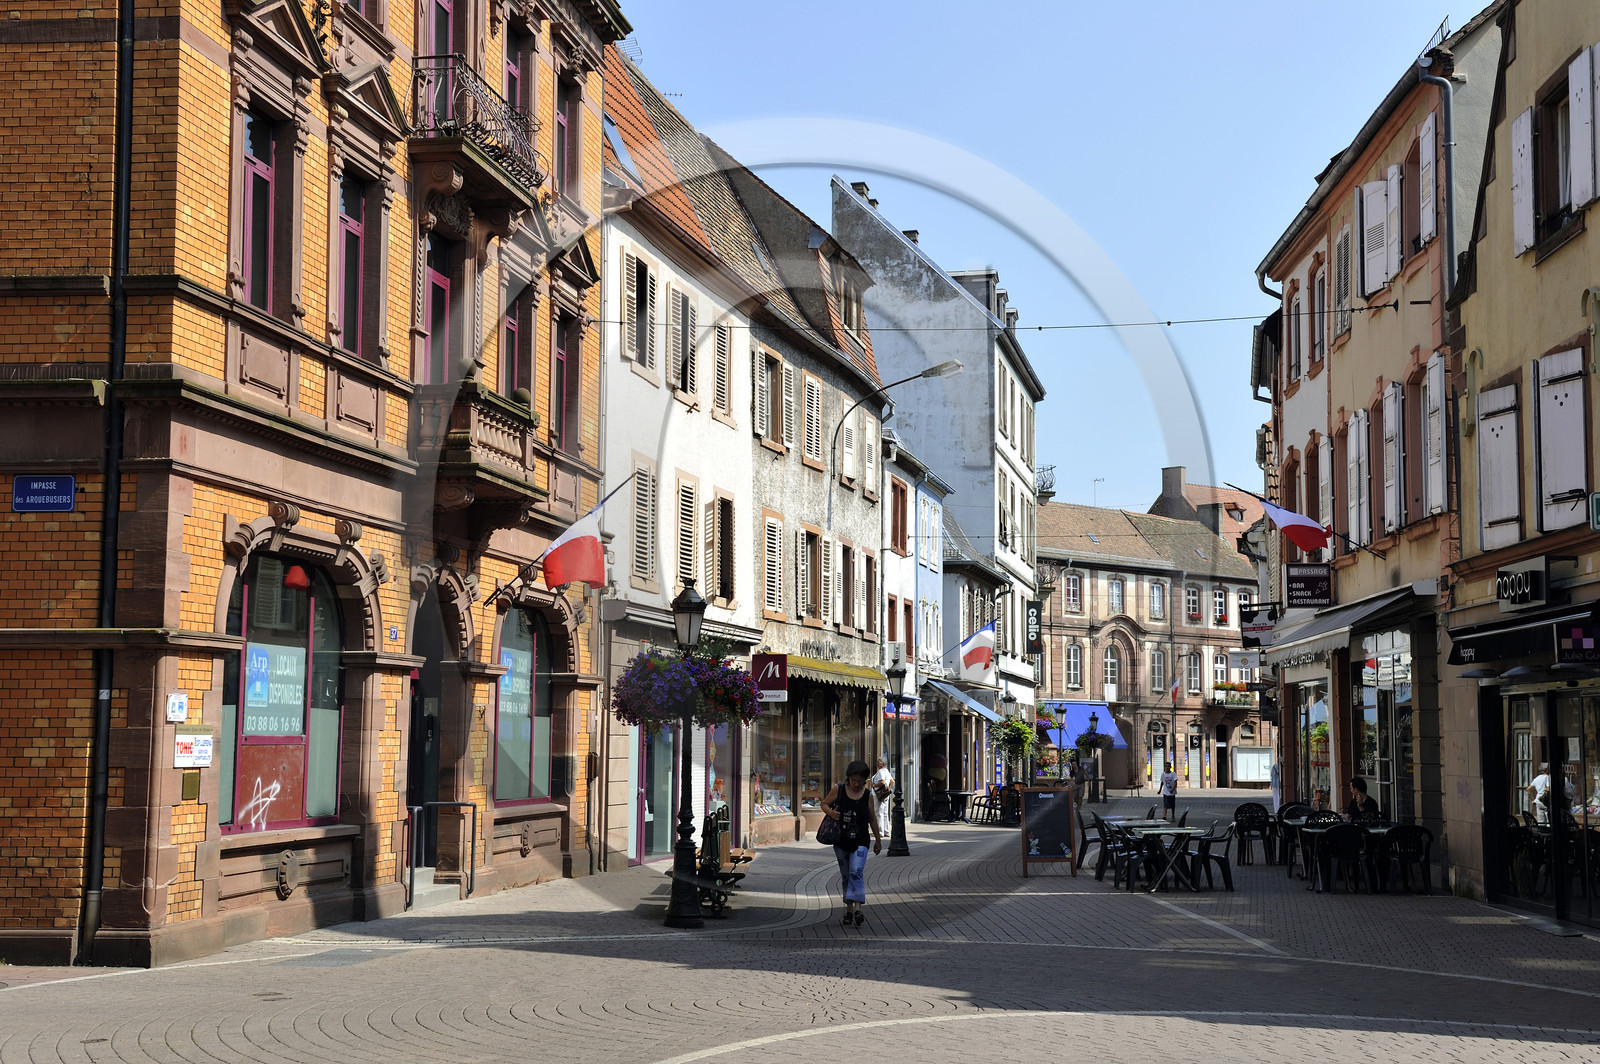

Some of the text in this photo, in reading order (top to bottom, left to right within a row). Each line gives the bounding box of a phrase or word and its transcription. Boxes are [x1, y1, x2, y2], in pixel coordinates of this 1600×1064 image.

[31, 481, 57, 490] IMPASSE
[26, 495, 71, 504] ARQUEBUSIERS
[1028, 608, 1040, 641] celio
[1460, 645, 1475, 661] happy
[250, 651, 268, 673] Arp
[277, 655, 297, 676] LOCAUX
[269, 682, 302, 705] DISPONIBLES
[246, 715, 300, 732] 03 88 06 16 96
[176, 742, 193, 754] TONIC
